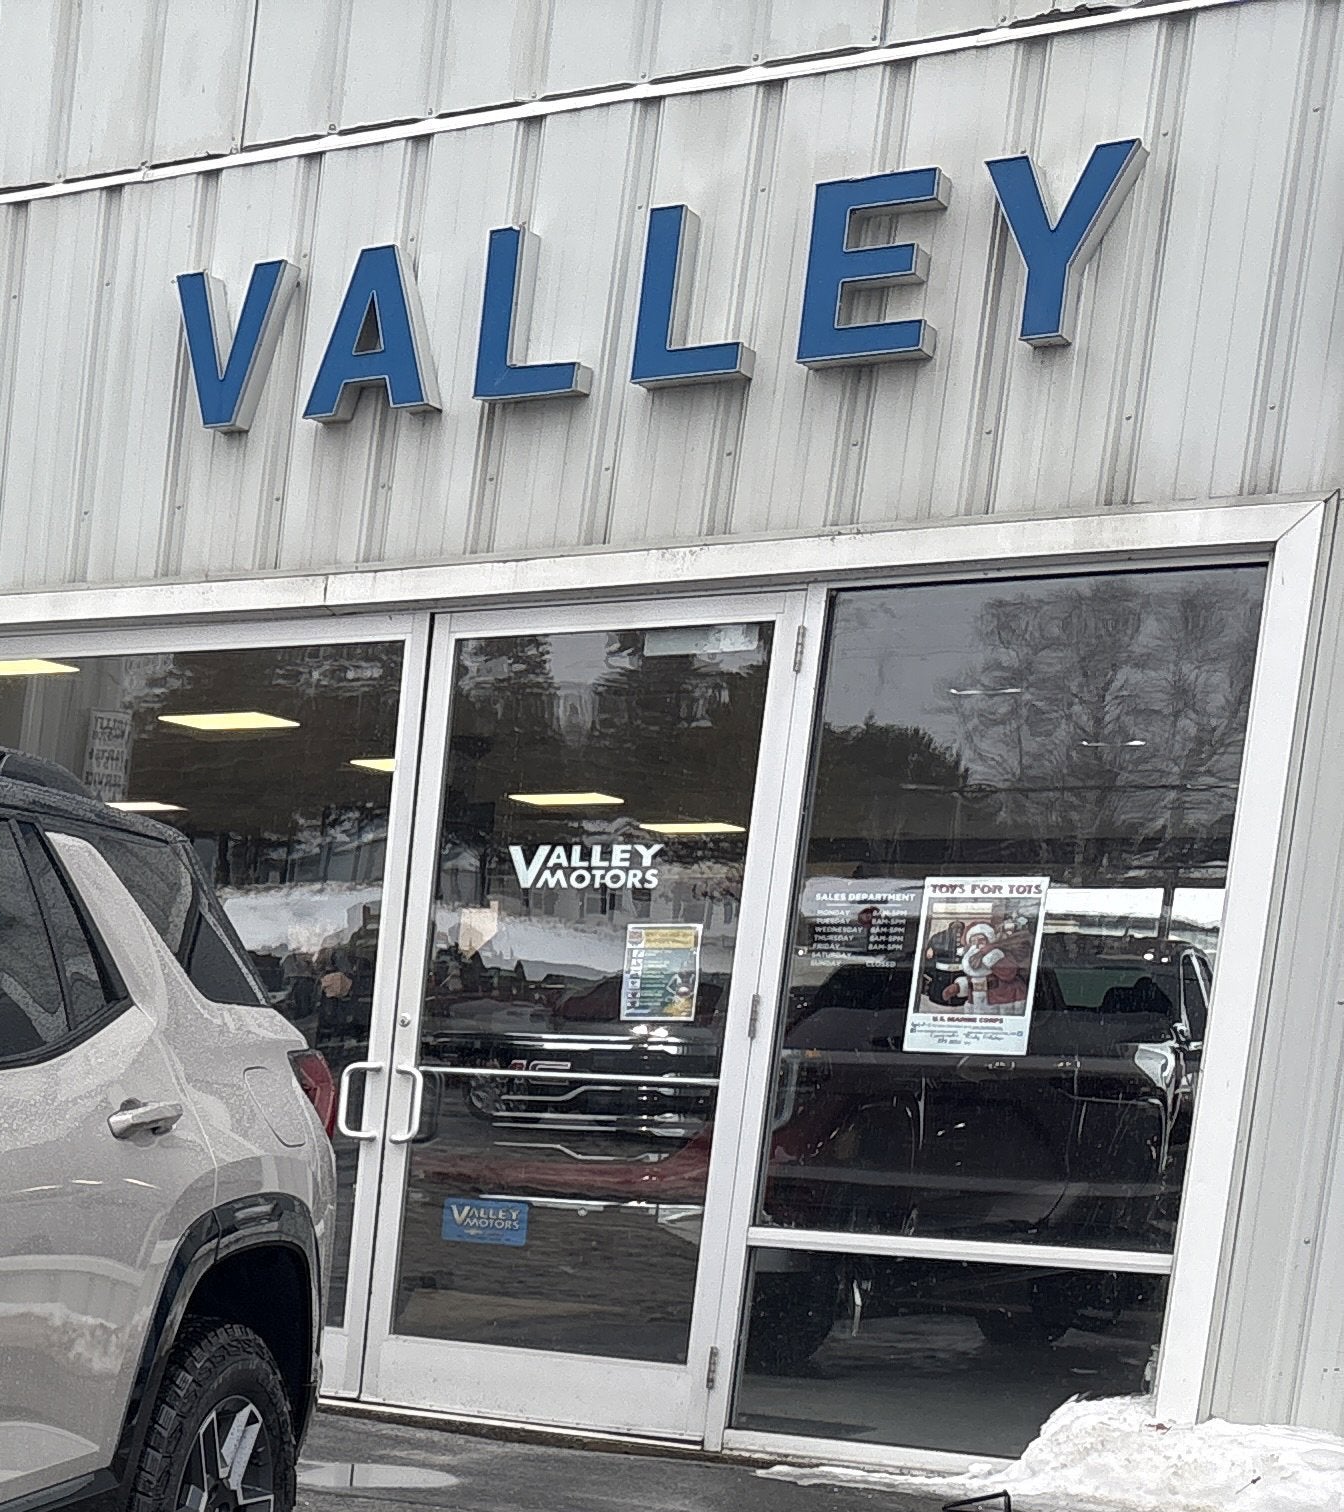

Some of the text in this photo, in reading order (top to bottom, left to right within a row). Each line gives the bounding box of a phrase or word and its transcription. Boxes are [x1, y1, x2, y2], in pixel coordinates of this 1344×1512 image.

[176, 138, 1148, 433] VALLEY
[509, 843, 664, 889] VALLEY
[535, 869, 659, 889] MOTORS
[815, 892, 916, 902] SALES DEPARTMENT
[931, 884, 1042, 895] TOYS FOR TOTS
[451, 1204, 521, 1224] VALLEY
[463, 1218, 520, 1230] MOTORS
